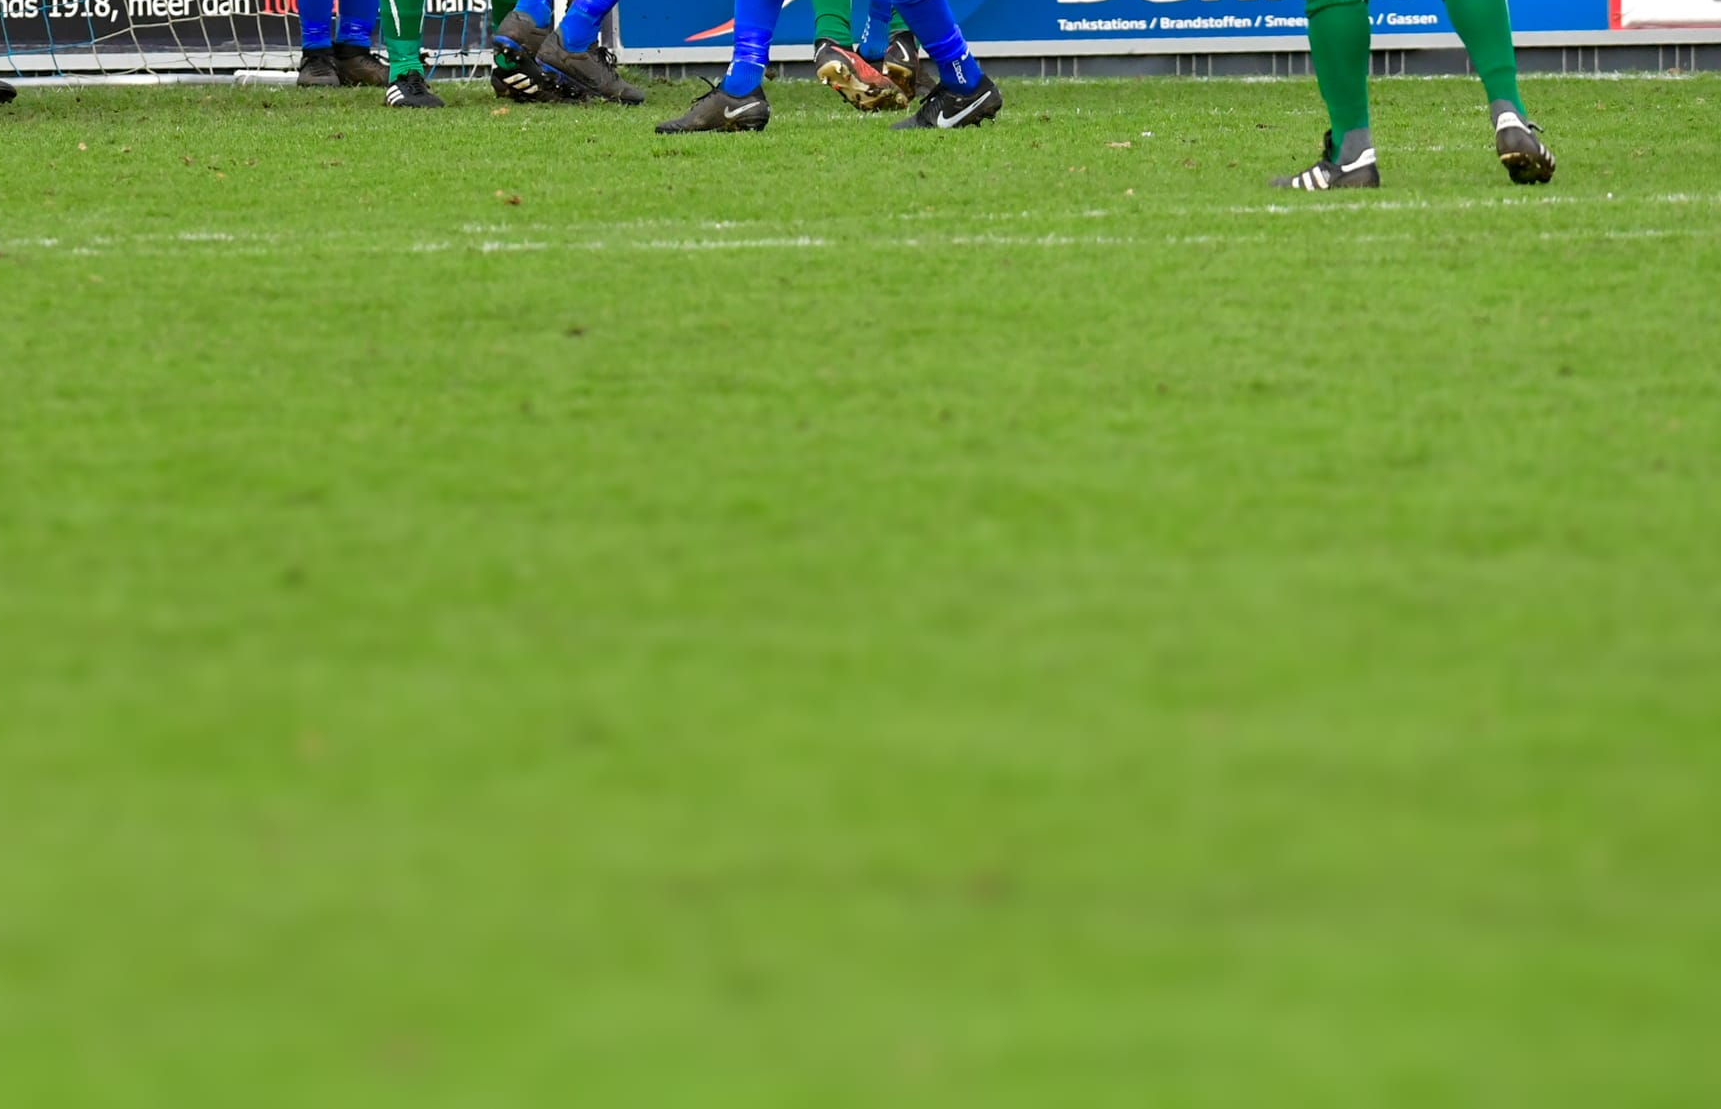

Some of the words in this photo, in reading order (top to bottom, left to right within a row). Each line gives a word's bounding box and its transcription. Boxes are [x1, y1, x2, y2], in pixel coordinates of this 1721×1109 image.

[1057, 17, 1147, 31] Tankstations
[1160, 15, 1252, 30] Brandstoffen
[1386, 12, 1438, 26] Gassen
